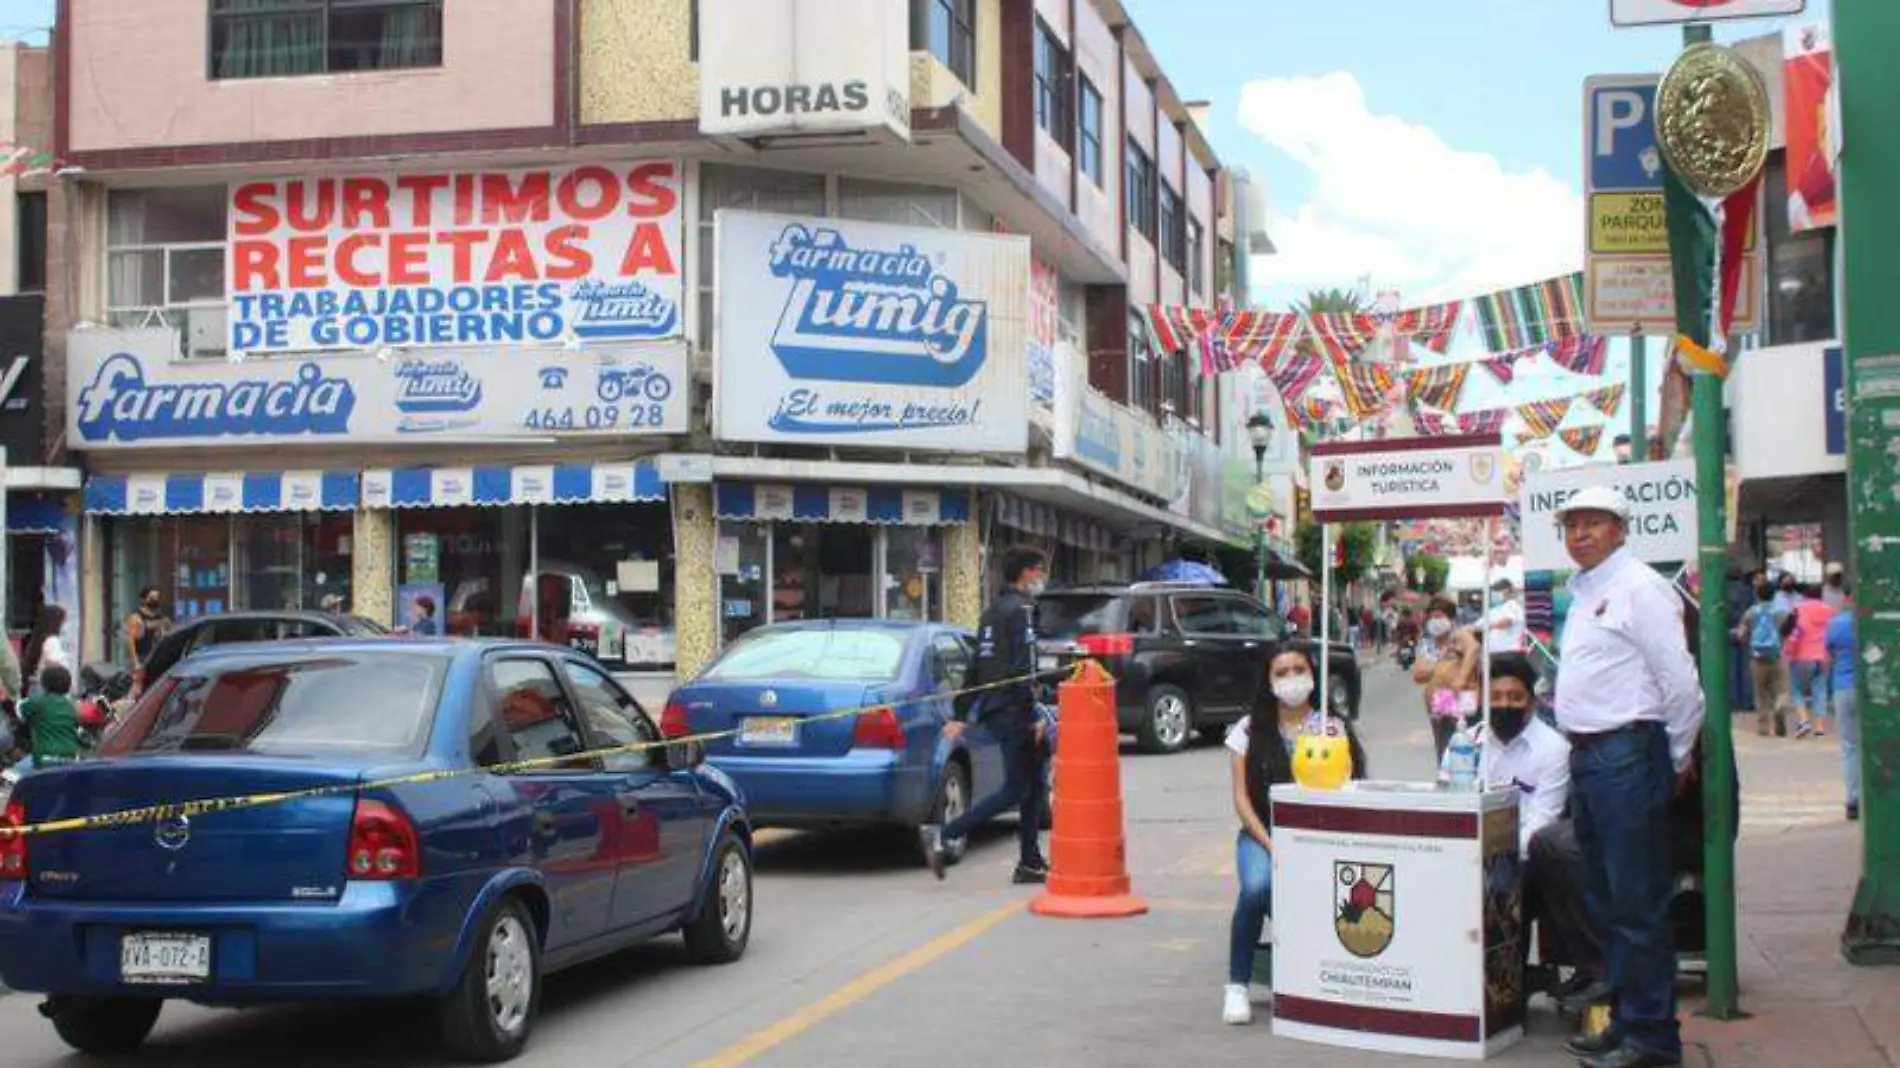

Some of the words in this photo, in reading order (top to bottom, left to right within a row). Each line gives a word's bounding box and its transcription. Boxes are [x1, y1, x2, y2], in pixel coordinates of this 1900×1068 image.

[721, 79, 869, 118] HORAS
[1597, 91, 1644, 156] P
[233, 162, 677, 236] SURTIMOS
[233, 224, 593, 291] RECETAS
[618, 221, 676, 276] A
[770, 223, 931, 279] farmacia
[232, 282, 563, 320] TRABAJADORES
[233, 320, 289, 350] DE
[310, 311, 565, 345] GOBIERNO
[770, 277, 987, 375] Lumig
[78, 353, 355, 438] farmacia
[525, 406, 575, 430] 464
[585, 405, 620, 428] 09
[630, 404, 665, 427] 28
[826, 401, 892, 423] mejor
[902, 398, 980, 425] precio!
[1530, 475, 1699, 512] INFACIÓN
